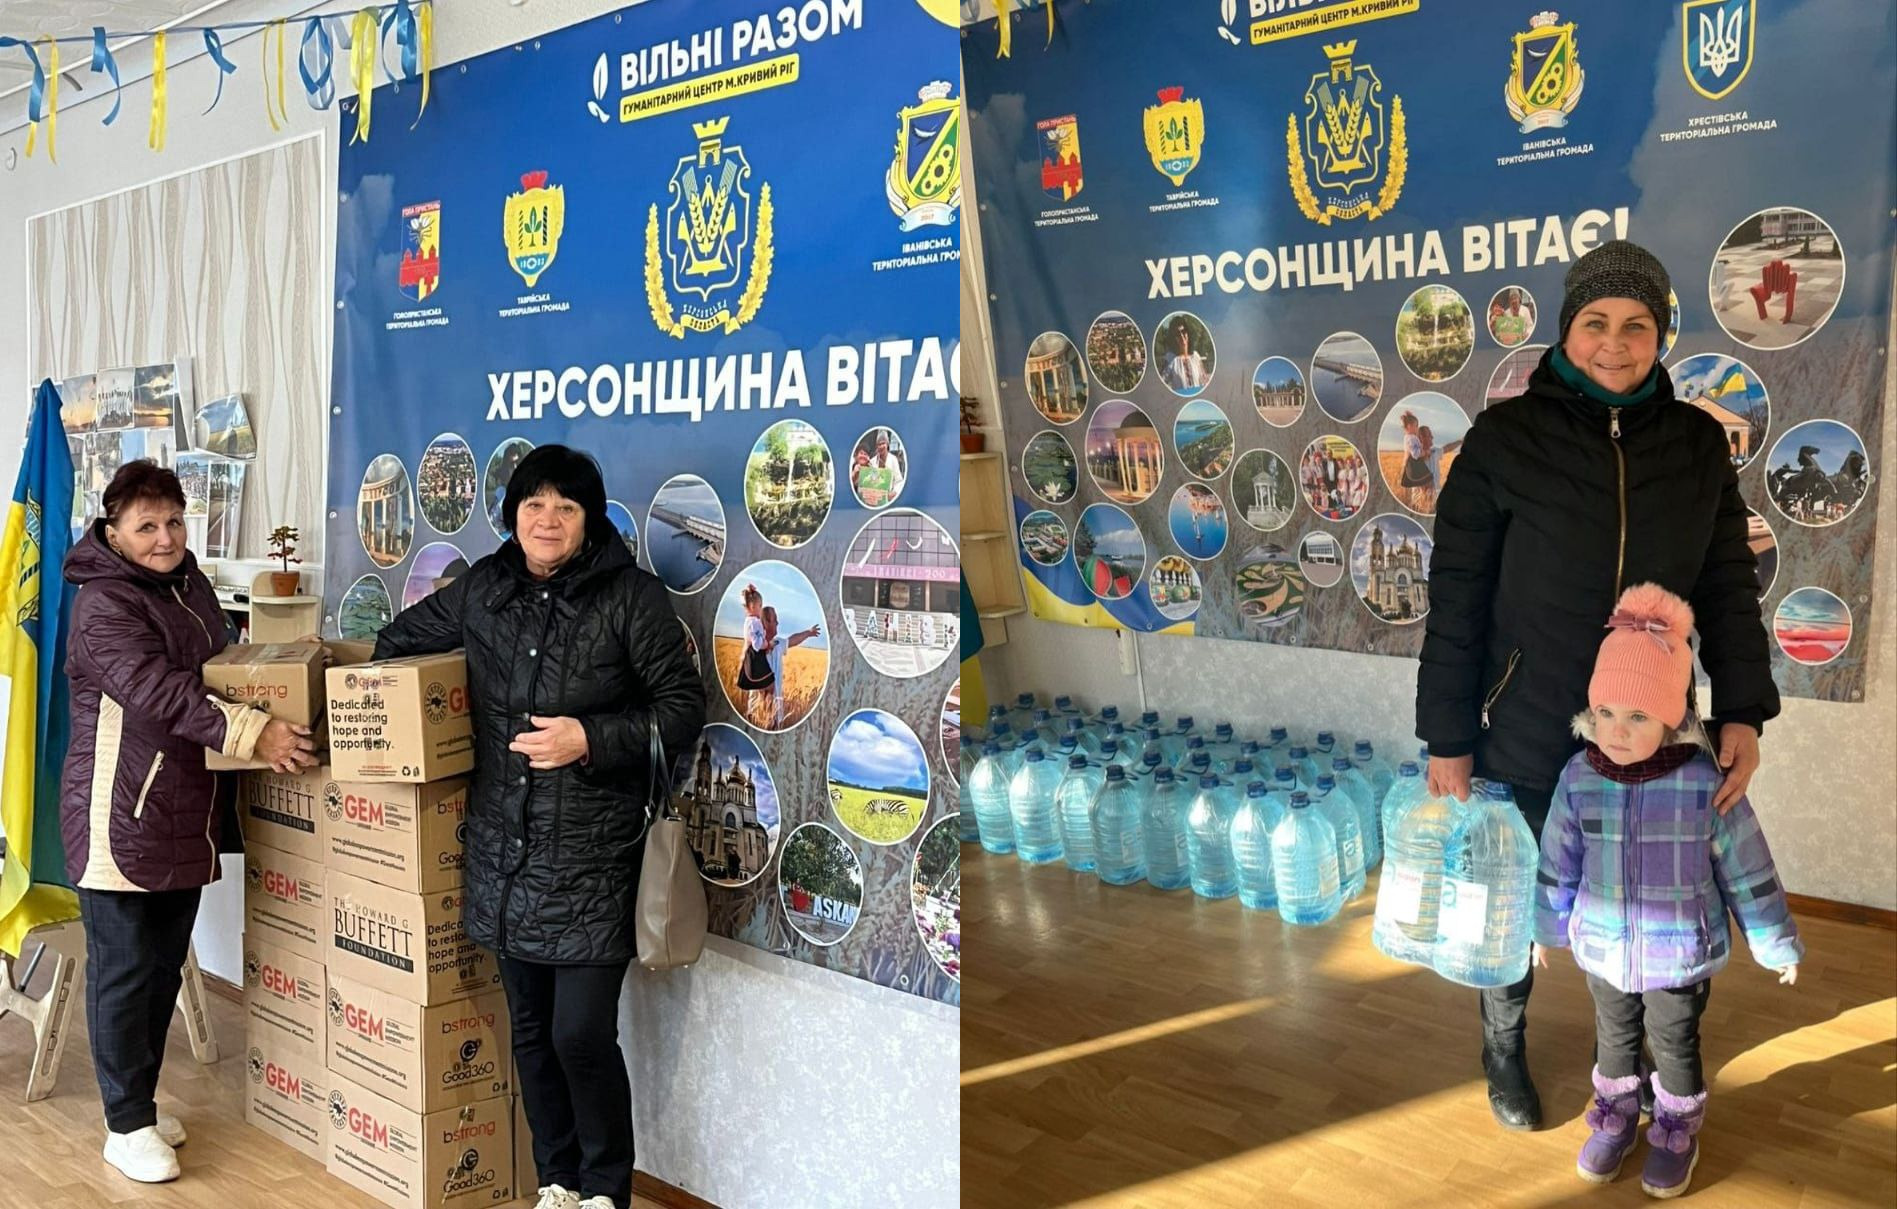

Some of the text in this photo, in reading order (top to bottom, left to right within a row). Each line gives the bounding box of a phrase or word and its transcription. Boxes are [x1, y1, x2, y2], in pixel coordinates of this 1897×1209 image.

[1254, 14, 1319, 38] ГУМАНІТАРНИЙ
[1320, 10, 1349, 25] ЦЕНТР
[620, 0, 863, 91] ВІЛЬНІ РАЗОМ
[624, 61, 795, 115] ГУМАНІТАРНИЙ ЦЕНТР М.КРИВИЙ РІГ
[1660, 120, 1777, 142] ТЕРИТОРІАЛЬНА ГРОМАДА
[1688, 111, 1748, 127] ХРЕСТІВСЬКА
[1497, 144, 1594, 166] ТЕРИТОРІАЛЬНА ГРОМАДА
[872, 253, 939, 271] ТЕРИТОРІАЛЬНА
[1145, 229, 1450, 299] ХЕРСОНЩИНА
[486, 349, 811, 422] ХЕРСОНЩИНА
[226, 683, 288, 699] bstrong
[331, 699, 385, 710] Dedicated
[331, 713, 388, 725] to restoring
[333, 725, 382, 737] hope and
[249, 782, 314, 818] BUFFETT
[345, 794, 385, 826] GEM
[264, 869, 298, 901] GEM
[334, 908, 413, 957] BUFFETT
[342, 938, 406, 969] FOUNDATION
[428, 948, 454, 961] hope
[262, 964, 297, 999] GEM
[345, 1003, 384, 1041] GEM
[442, 1013, 495, 1034] bstrong
[265, 1062, 300, 1100] GEM
[442, 1061, 495, 1084] Good360
[348, 1107, 388, 1148] GEM
[443, 1120, 496, 1143] bstrong
[443, 1169, 495, 1193] Good360
